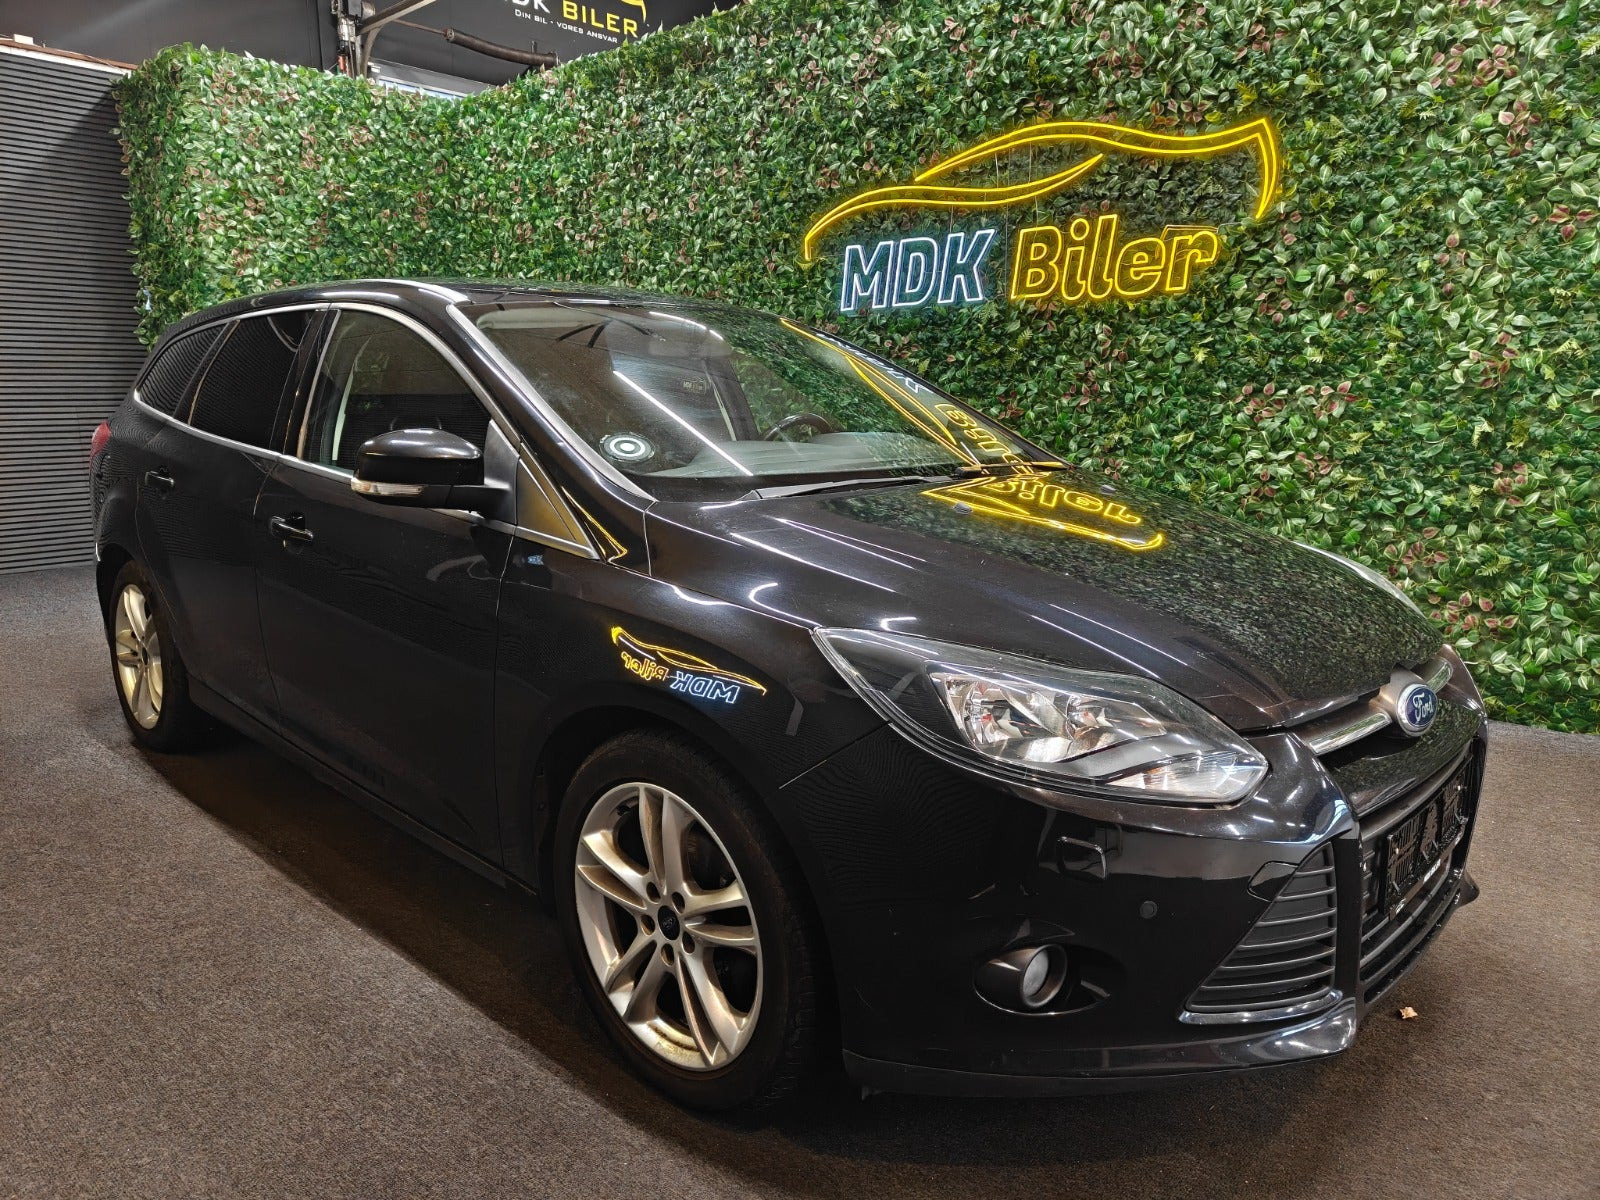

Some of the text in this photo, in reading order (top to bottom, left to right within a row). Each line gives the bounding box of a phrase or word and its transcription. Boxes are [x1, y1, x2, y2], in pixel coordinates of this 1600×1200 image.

[514, 8, 618, 44] DIN BIL VORES ANSVAR
[562, 0, 638, 38] BILER
[840, 214, 1219, 312] MDK Biler
[1412, 692, 1434, 724] Ford
